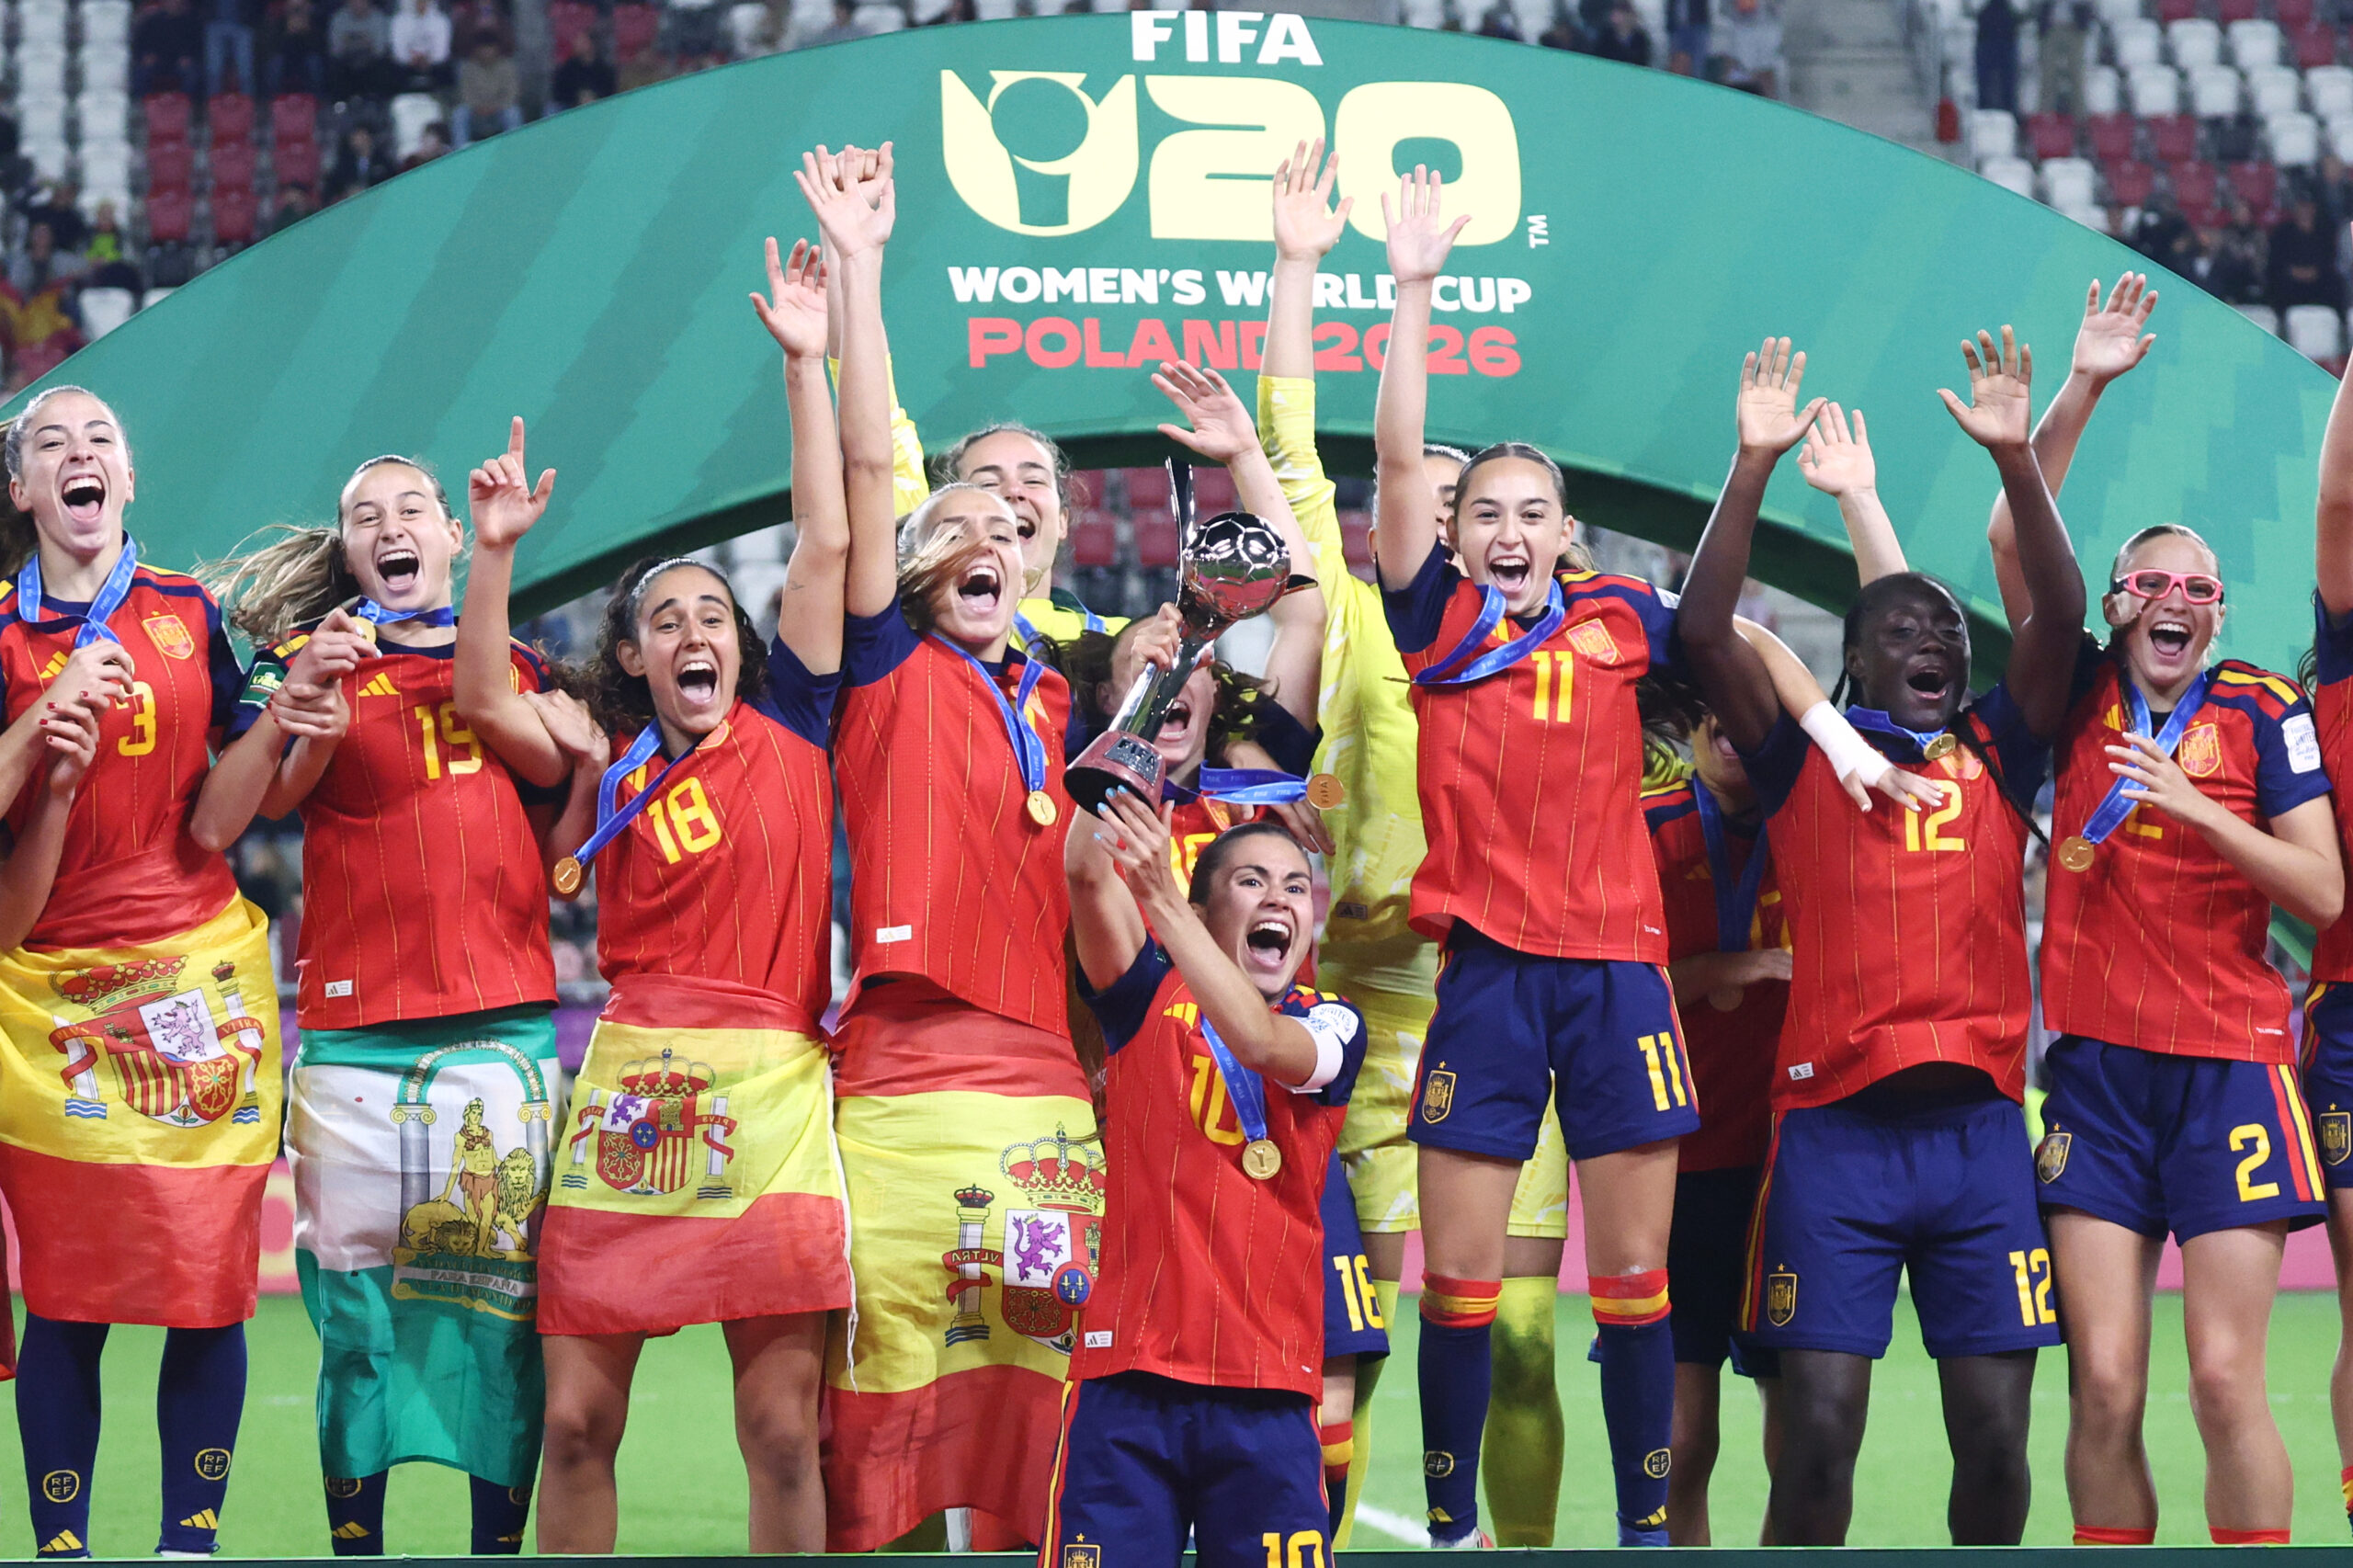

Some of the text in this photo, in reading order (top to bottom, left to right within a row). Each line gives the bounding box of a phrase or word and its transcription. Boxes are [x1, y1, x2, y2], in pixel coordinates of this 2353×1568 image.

[1131, 10, 1324, 66] FIFA
[941, 69, 1521, 246] U20
[1528, 214, 1550, 248] TM
[948, 267, 1532, 313] WOMEN'S WRLD CUP
[969, 317, 1267, 369] POLAND
[115, 681, 156, 756] 3
[1531, 651, 1574, 722] 11
[415, 702, 483, 780] 19
[1118, 739, 1155, 766] FIFA
[646, 777, 722, 865] 18
[1320, 781, 1329, 804] FIFA
[1905, 779, 1965, 851] 12
[1190, 1054, 1245, 1146] 10
[1637, 1031, 1687, 1112] 11
[2229, 1123, 2280, 1202] 2
[1333, 1254, 1385, 1332] 16
[2008, 1247, 2057, 1326] 12
